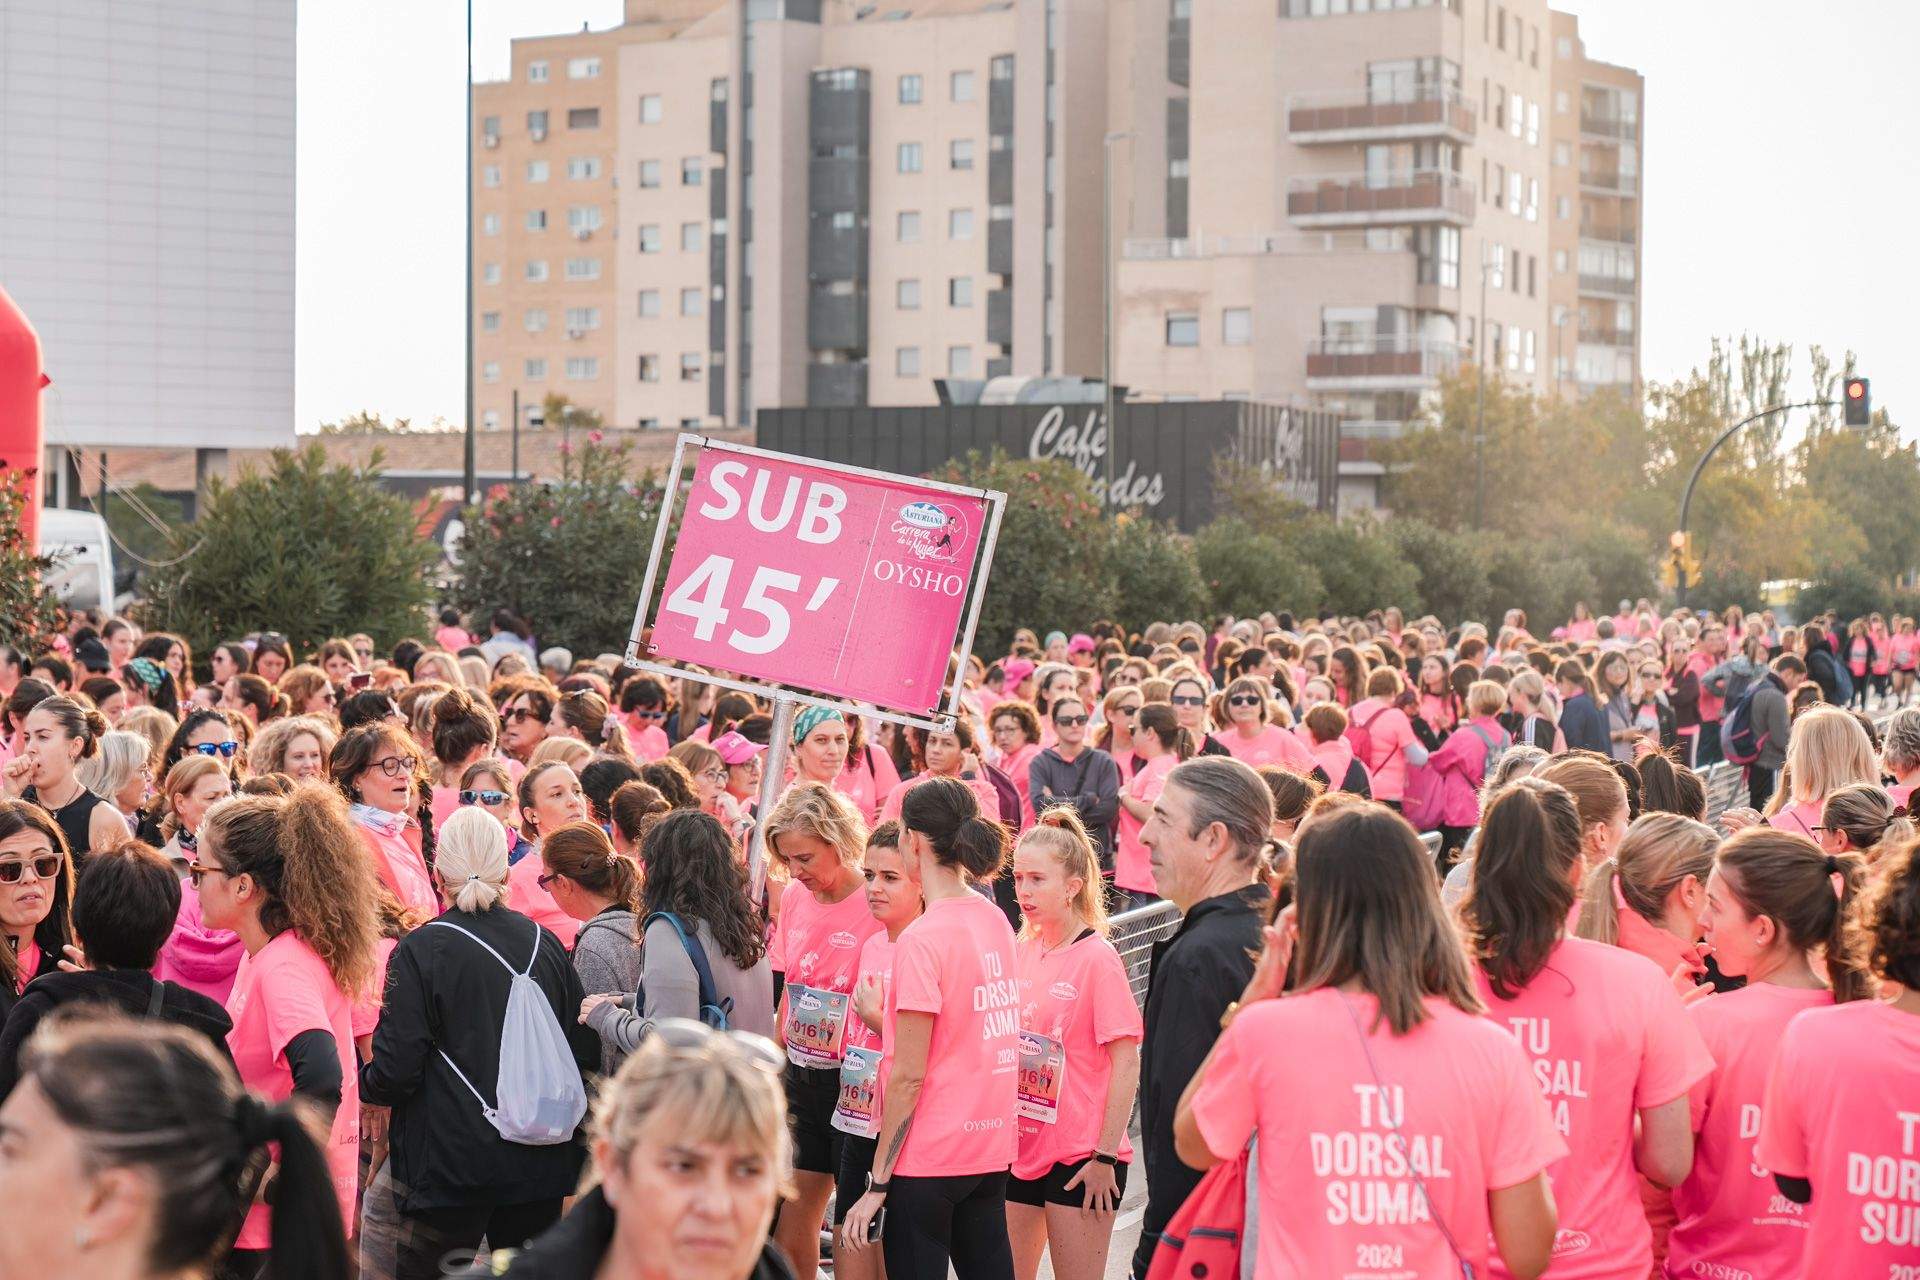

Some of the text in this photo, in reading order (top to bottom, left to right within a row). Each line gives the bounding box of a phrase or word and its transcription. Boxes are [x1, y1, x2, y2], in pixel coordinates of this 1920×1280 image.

[699, 460, 848, 545] SUB
[902, 506, 944, 526] ASTURIANA
[891, 520, 932, 541] Carrera
[908, 537, 942, 560] Mujer
[873, 559, 963, 597] OYSHO
[984, 951, 1002, 979] TU
[1507, 1016, 1550, 1055] TU
[844, 1083, 860, 1100] 16
[1020, 1068, 1038, 1085] 16
[1533, 1058, 1589, 1099] SAL
[964, 1116, 1004, 1132] OYSHO
[1353, 1083, 1404, 1129] TU
[1896, 1111, 1920, 1155] T
[1310, 1131, 1452, 1178] DORSAL
[1847, 1151, 1920, 1203] DOR
[1325, 1180, 1430, 1226] SUMA
[1860, 1201, 1920, 1247] SU
[1356, 1243, 1404, 1269] 2024
[1888, 1262, 1920, 1280] 202
